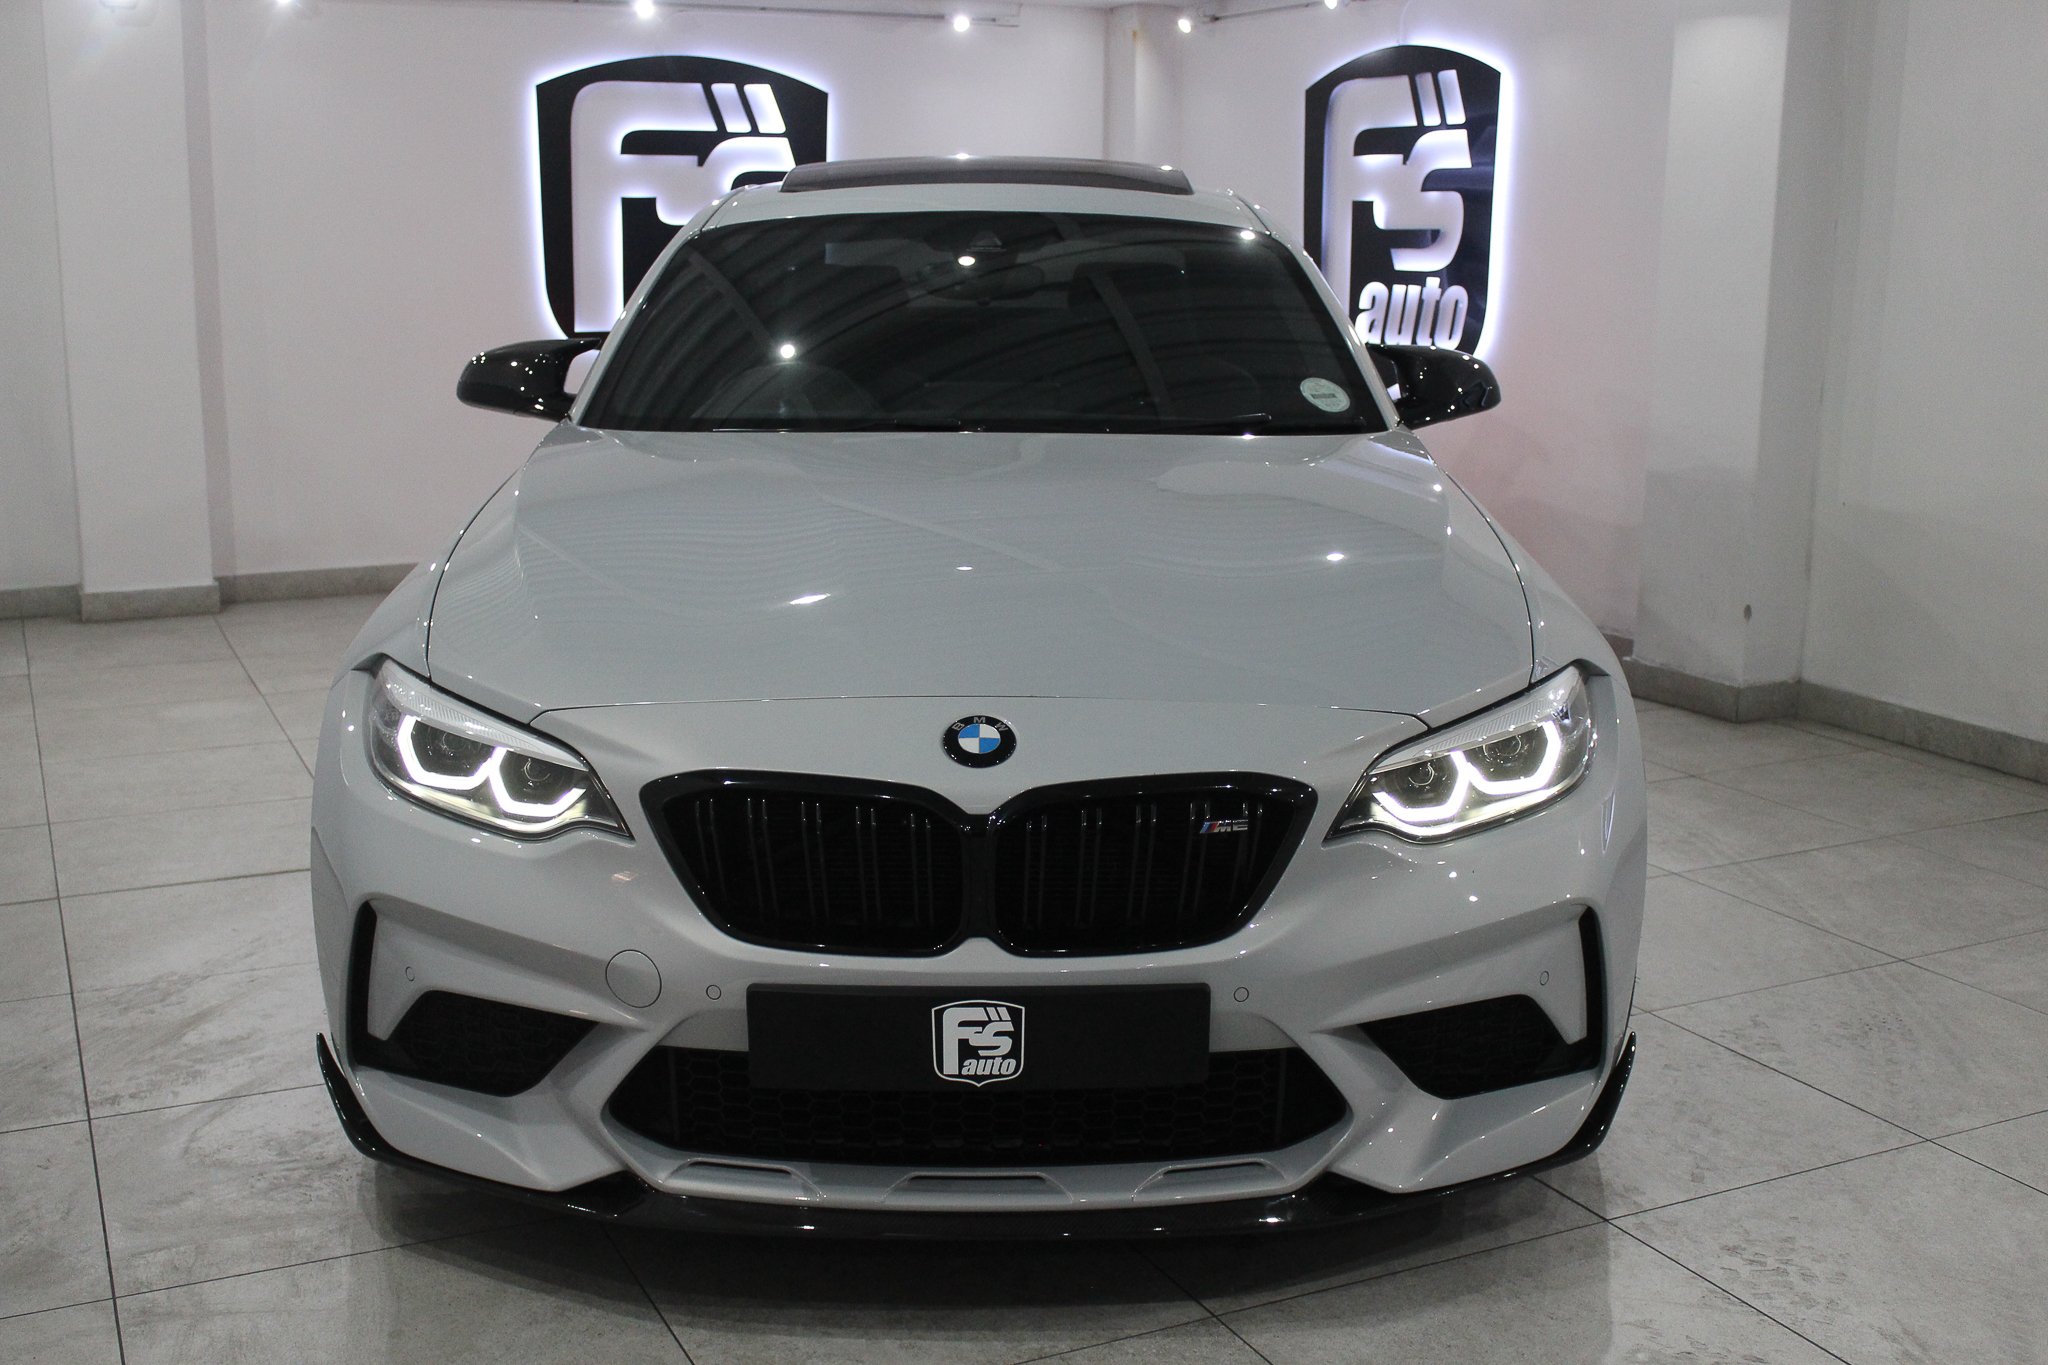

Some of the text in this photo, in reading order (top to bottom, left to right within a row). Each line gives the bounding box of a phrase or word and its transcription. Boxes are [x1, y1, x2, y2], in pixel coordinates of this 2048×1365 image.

[1321, 69, 1472, 332] FS
[1355, 277, 1468, 350] auto
[952, 717, 1008, 731] BMW
[943, 1007, 1014, 1074] FS
[961, 1057, 1016, 1075] auto
